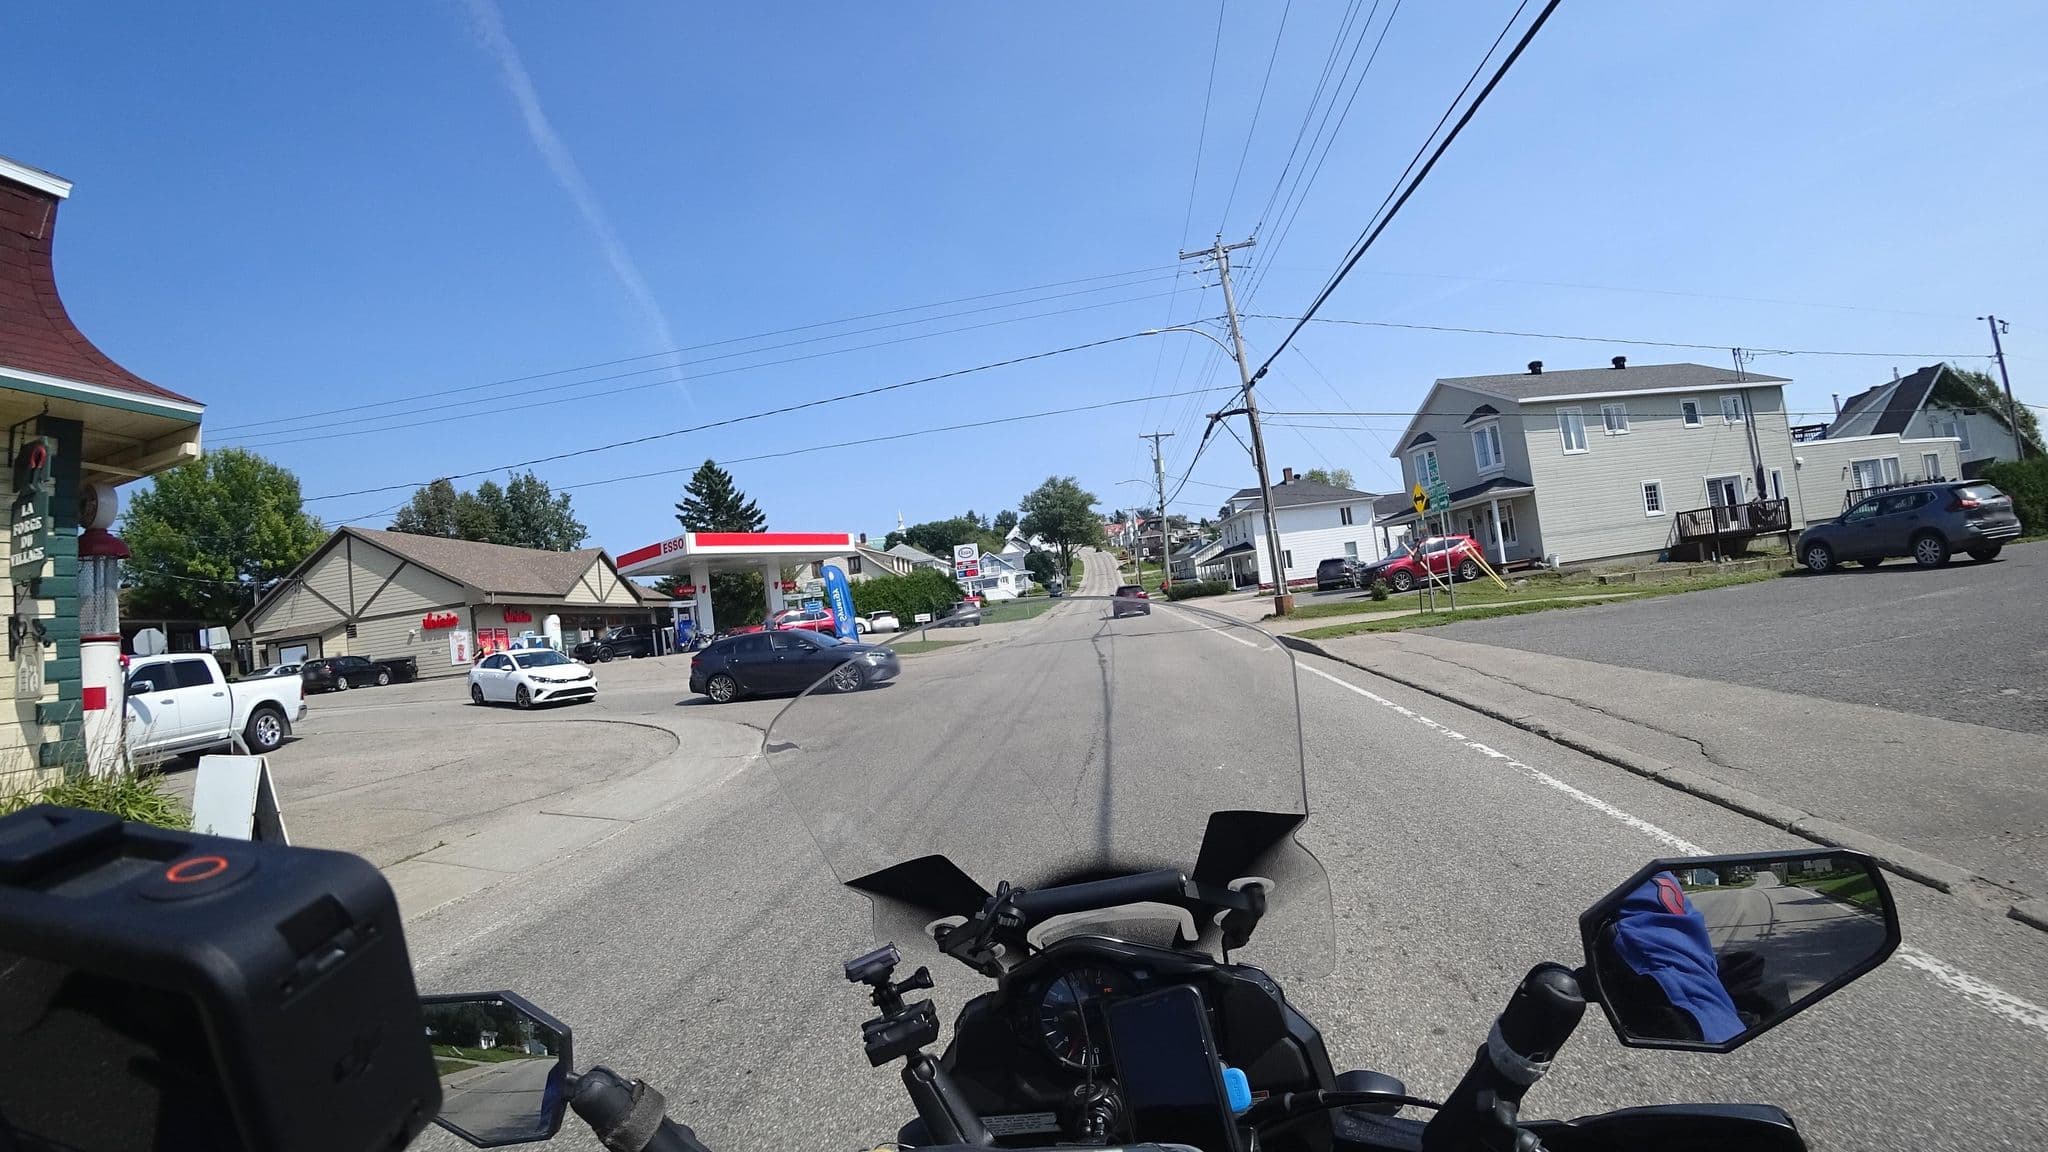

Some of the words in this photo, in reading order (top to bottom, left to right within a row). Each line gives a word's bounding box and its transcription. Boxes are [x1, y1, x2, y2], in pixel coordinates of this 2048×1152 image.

[21, 502, 34, 517] LA
[13, 517, 42, 537] FORGE
[21, 534, 33, 549] DU
[663, 538, 684, 554] ESSO
[10, 547, 45, 567] VILLAGE
